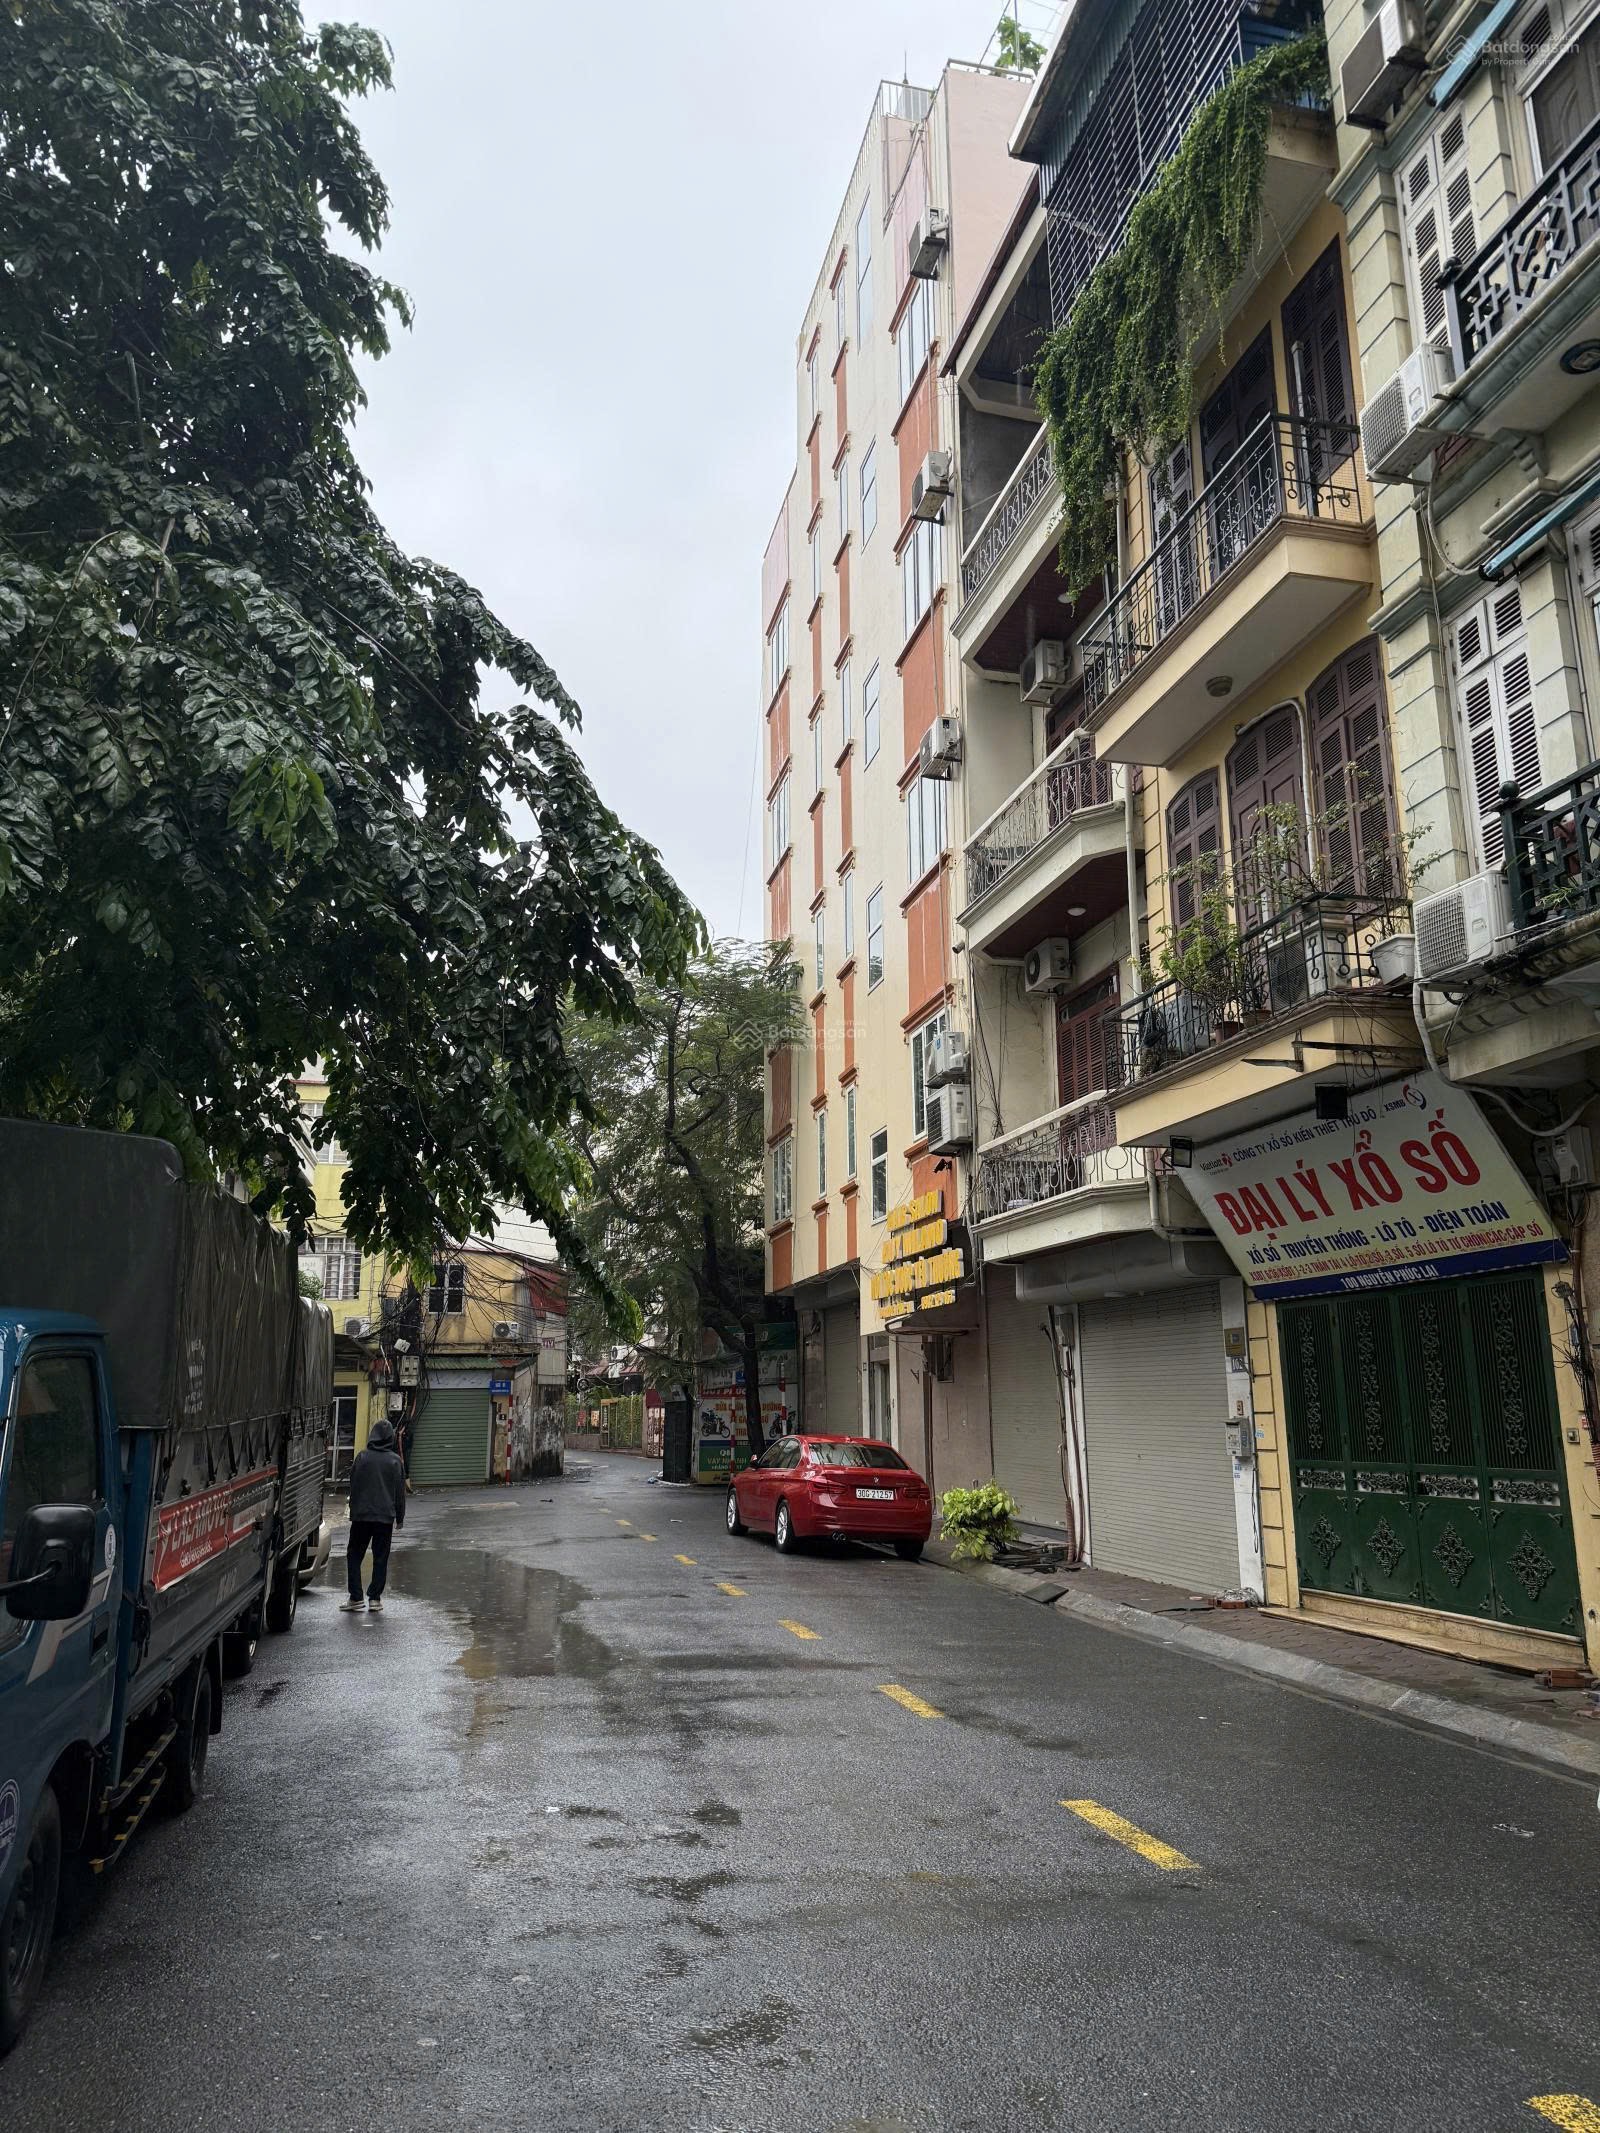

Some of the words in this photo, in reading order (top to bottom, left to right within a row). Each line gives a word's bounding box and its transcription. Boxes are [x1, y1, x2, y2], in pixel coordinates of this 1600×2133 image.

[1384, 1099, 1406, 1112] XSMB
[1232, 1147, 1256, 1162] CÔNG
[1256, 1144, 1267, 1155] TY
[1267, 1132, 1281, 1152] XỔ
[1280, 1129, 1294, 1147] SỐ
[1360, 1105, 1377, 1122] ĐÔ
[1214, 1181, 1290, 1240] ĐẠI
[1275, 1158, 1336, 1223] LÝ
[1327, 1128, 1404, 1211] XỔ
[1399, 1108, 1482, 1194] SỐ
[1246, 1243, 1266, 1265] XỔ
[1262, 1240, 1282, 1263] SỐ
[1281, 1234, 1329, 1259] TRUYỀN
[1324, 1226, 1371, 1252] THỐNG
[1375, 1220, 1397, 1242] LÔ
[1394, 1217, 1417, 1239] TÔ
[1423, 1209, 1466, 1234] ĐIỆN
[1460, 1199, 1511, 1226] TOÁN
[1526, 1218, 1544, 1237] SỐ
[1340, 1277, 1359, 1290] 100
[1356, 1269, 1396, 1288] NGUYỄN
[1393, 1266, 1423, 1284] PHÚC
[1422, 1264, 1439, 1279] LAI
